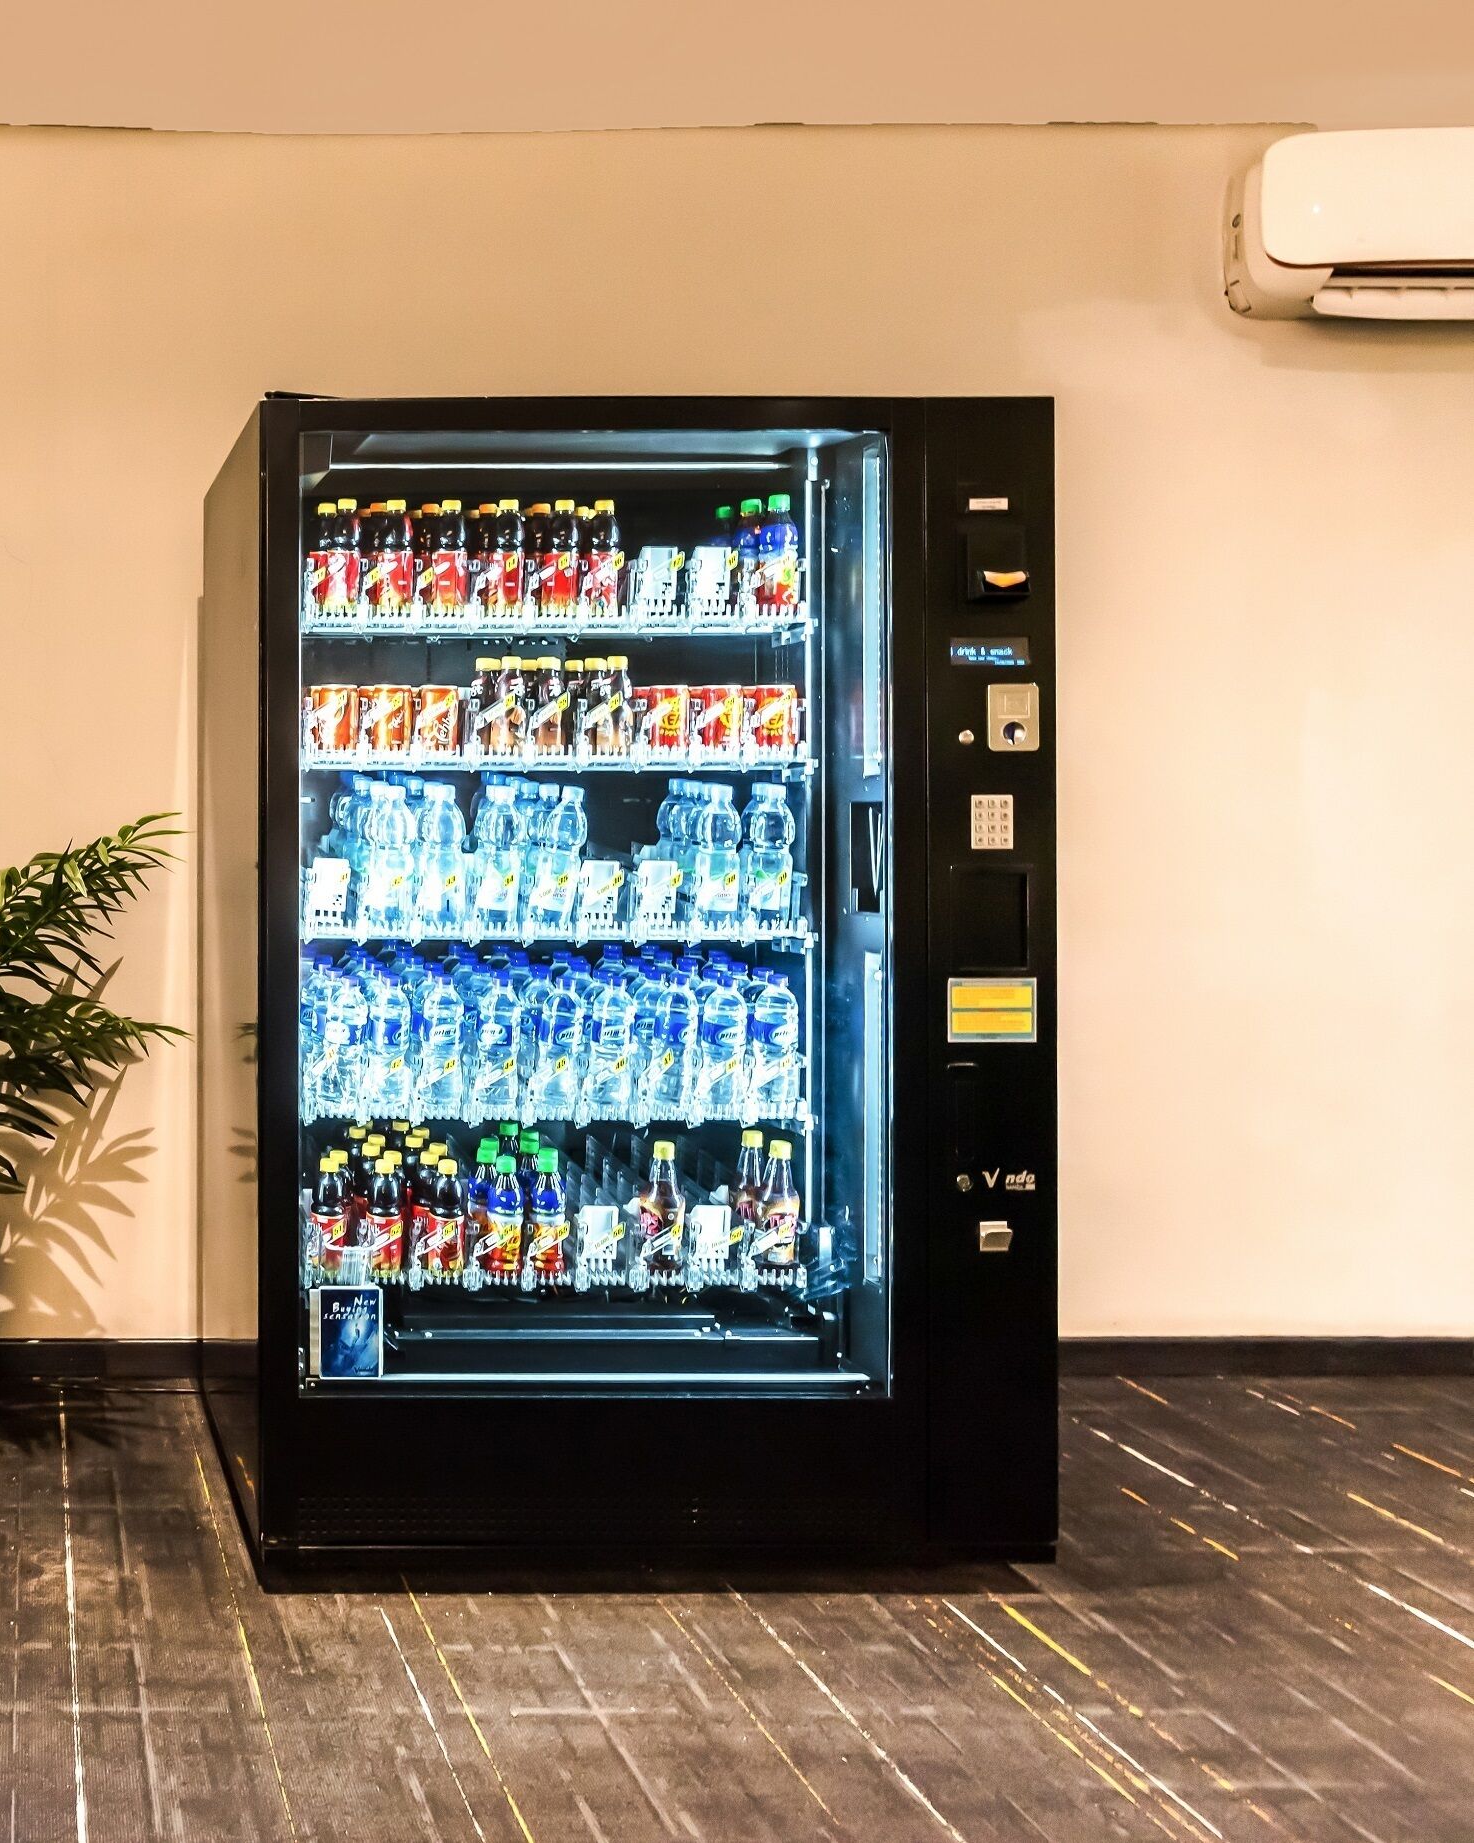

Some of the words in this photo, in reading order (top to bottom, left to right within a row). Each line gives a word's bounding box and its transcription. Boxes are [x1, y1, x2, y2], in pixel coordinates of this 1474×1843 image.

[982, 1168, 1036, 1188] Vndo
[353, 1294, 377, 1308] New
[332, 1302, 368, 1315] Buying
